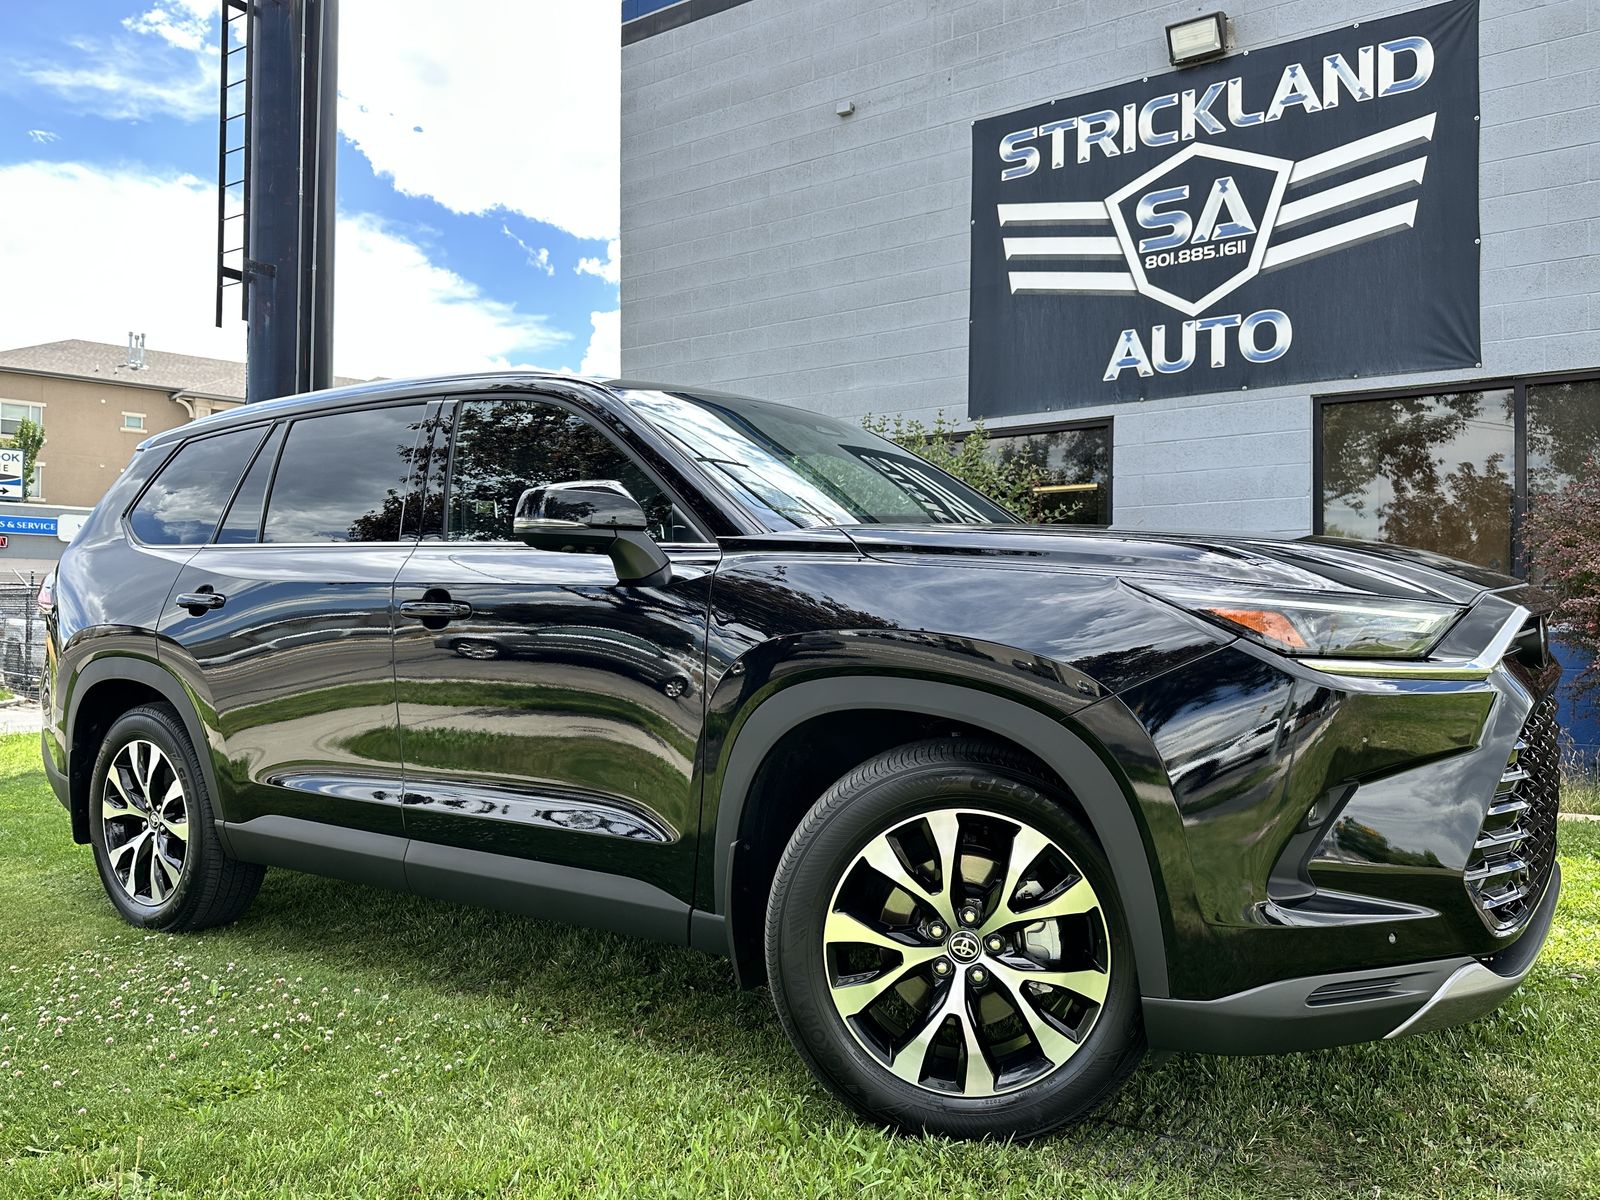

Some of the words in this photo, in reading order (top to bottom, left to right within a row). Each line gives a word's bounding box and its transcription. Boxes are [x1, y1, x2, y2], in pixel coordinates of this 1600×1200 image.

[999, 36, 1435, 181] STRICKLAND
[1135, 176, 1257, 254] SA
[1144, 239, 1247, 269] 801.885.1611
[1103, 308, 1293, 381] AUTO
[17, 522, 56, 531] SERVICE
